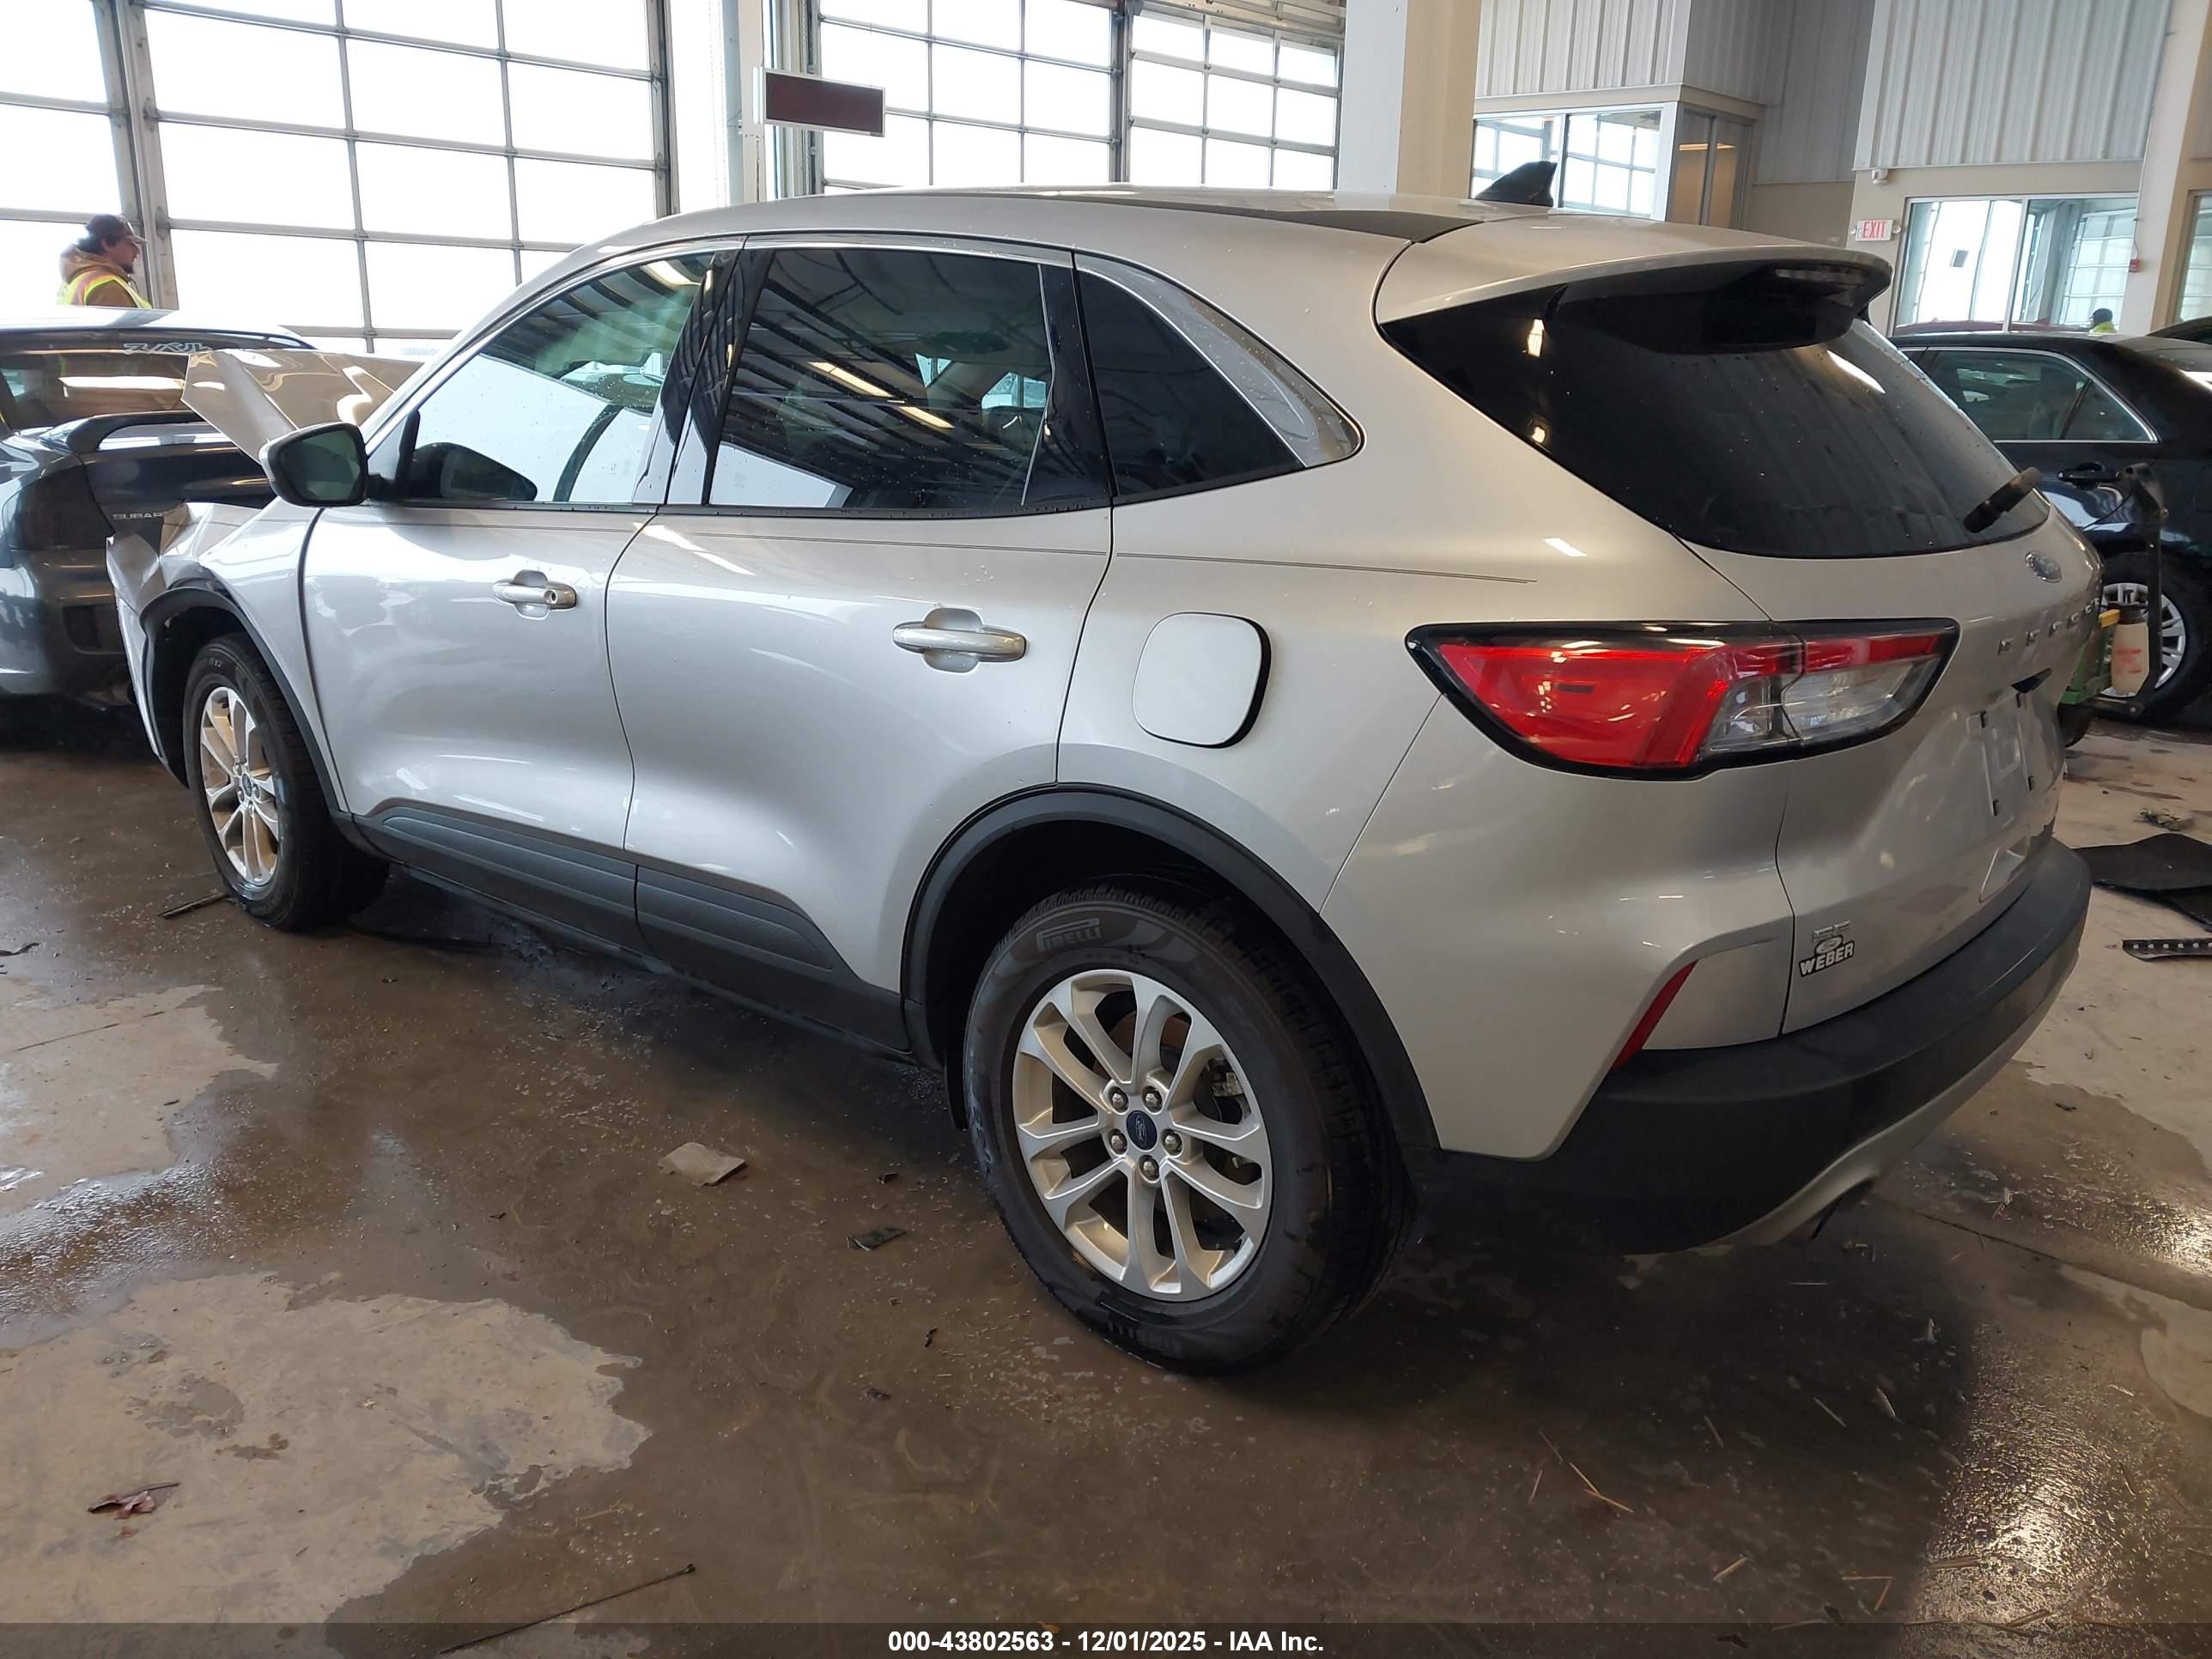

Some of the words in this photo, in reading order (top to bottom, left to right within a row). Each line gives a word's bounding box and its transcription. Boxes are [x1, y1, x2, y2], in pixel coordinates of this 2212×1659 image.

[1863, 221, 1887, 239] EXIT
[112, 512, 164, 520] SUBAR
[1036, 918, 1102, 951] PIRELLI
[1800, 941, 1855, 976] WEBER
